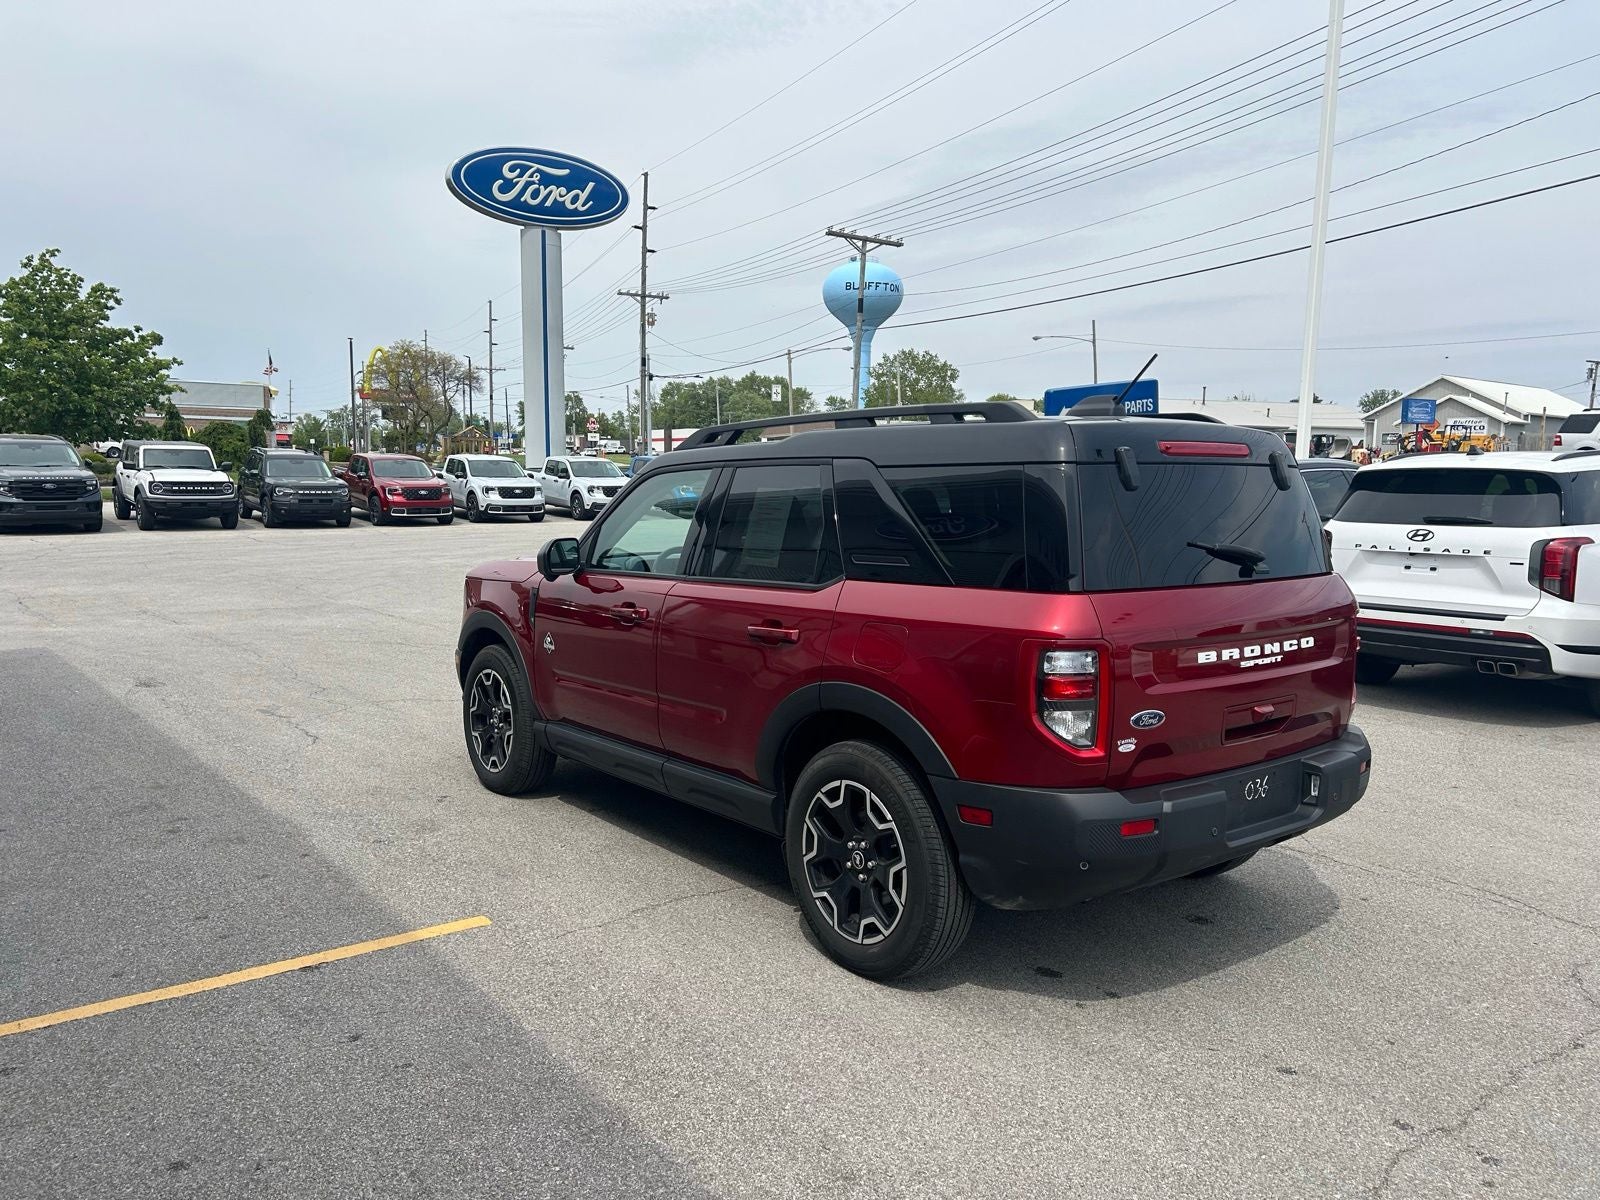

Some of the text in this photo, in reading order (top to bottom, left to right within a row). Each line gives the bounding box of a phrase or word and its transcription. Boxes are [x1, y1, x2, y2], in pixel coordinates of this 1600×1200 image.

[492, 160, 595, 211] Ford
[1124, 399, 1154, 413] PARTS
[1355, 543, 1492, 556] PALISADE
[1198, 637, 1315, 663] BRONCO
[1240, 655, 1284, 668] SPORT
[1140, 714, 1159, 725] Ford
[1245, 775, 1269, 800] 036
